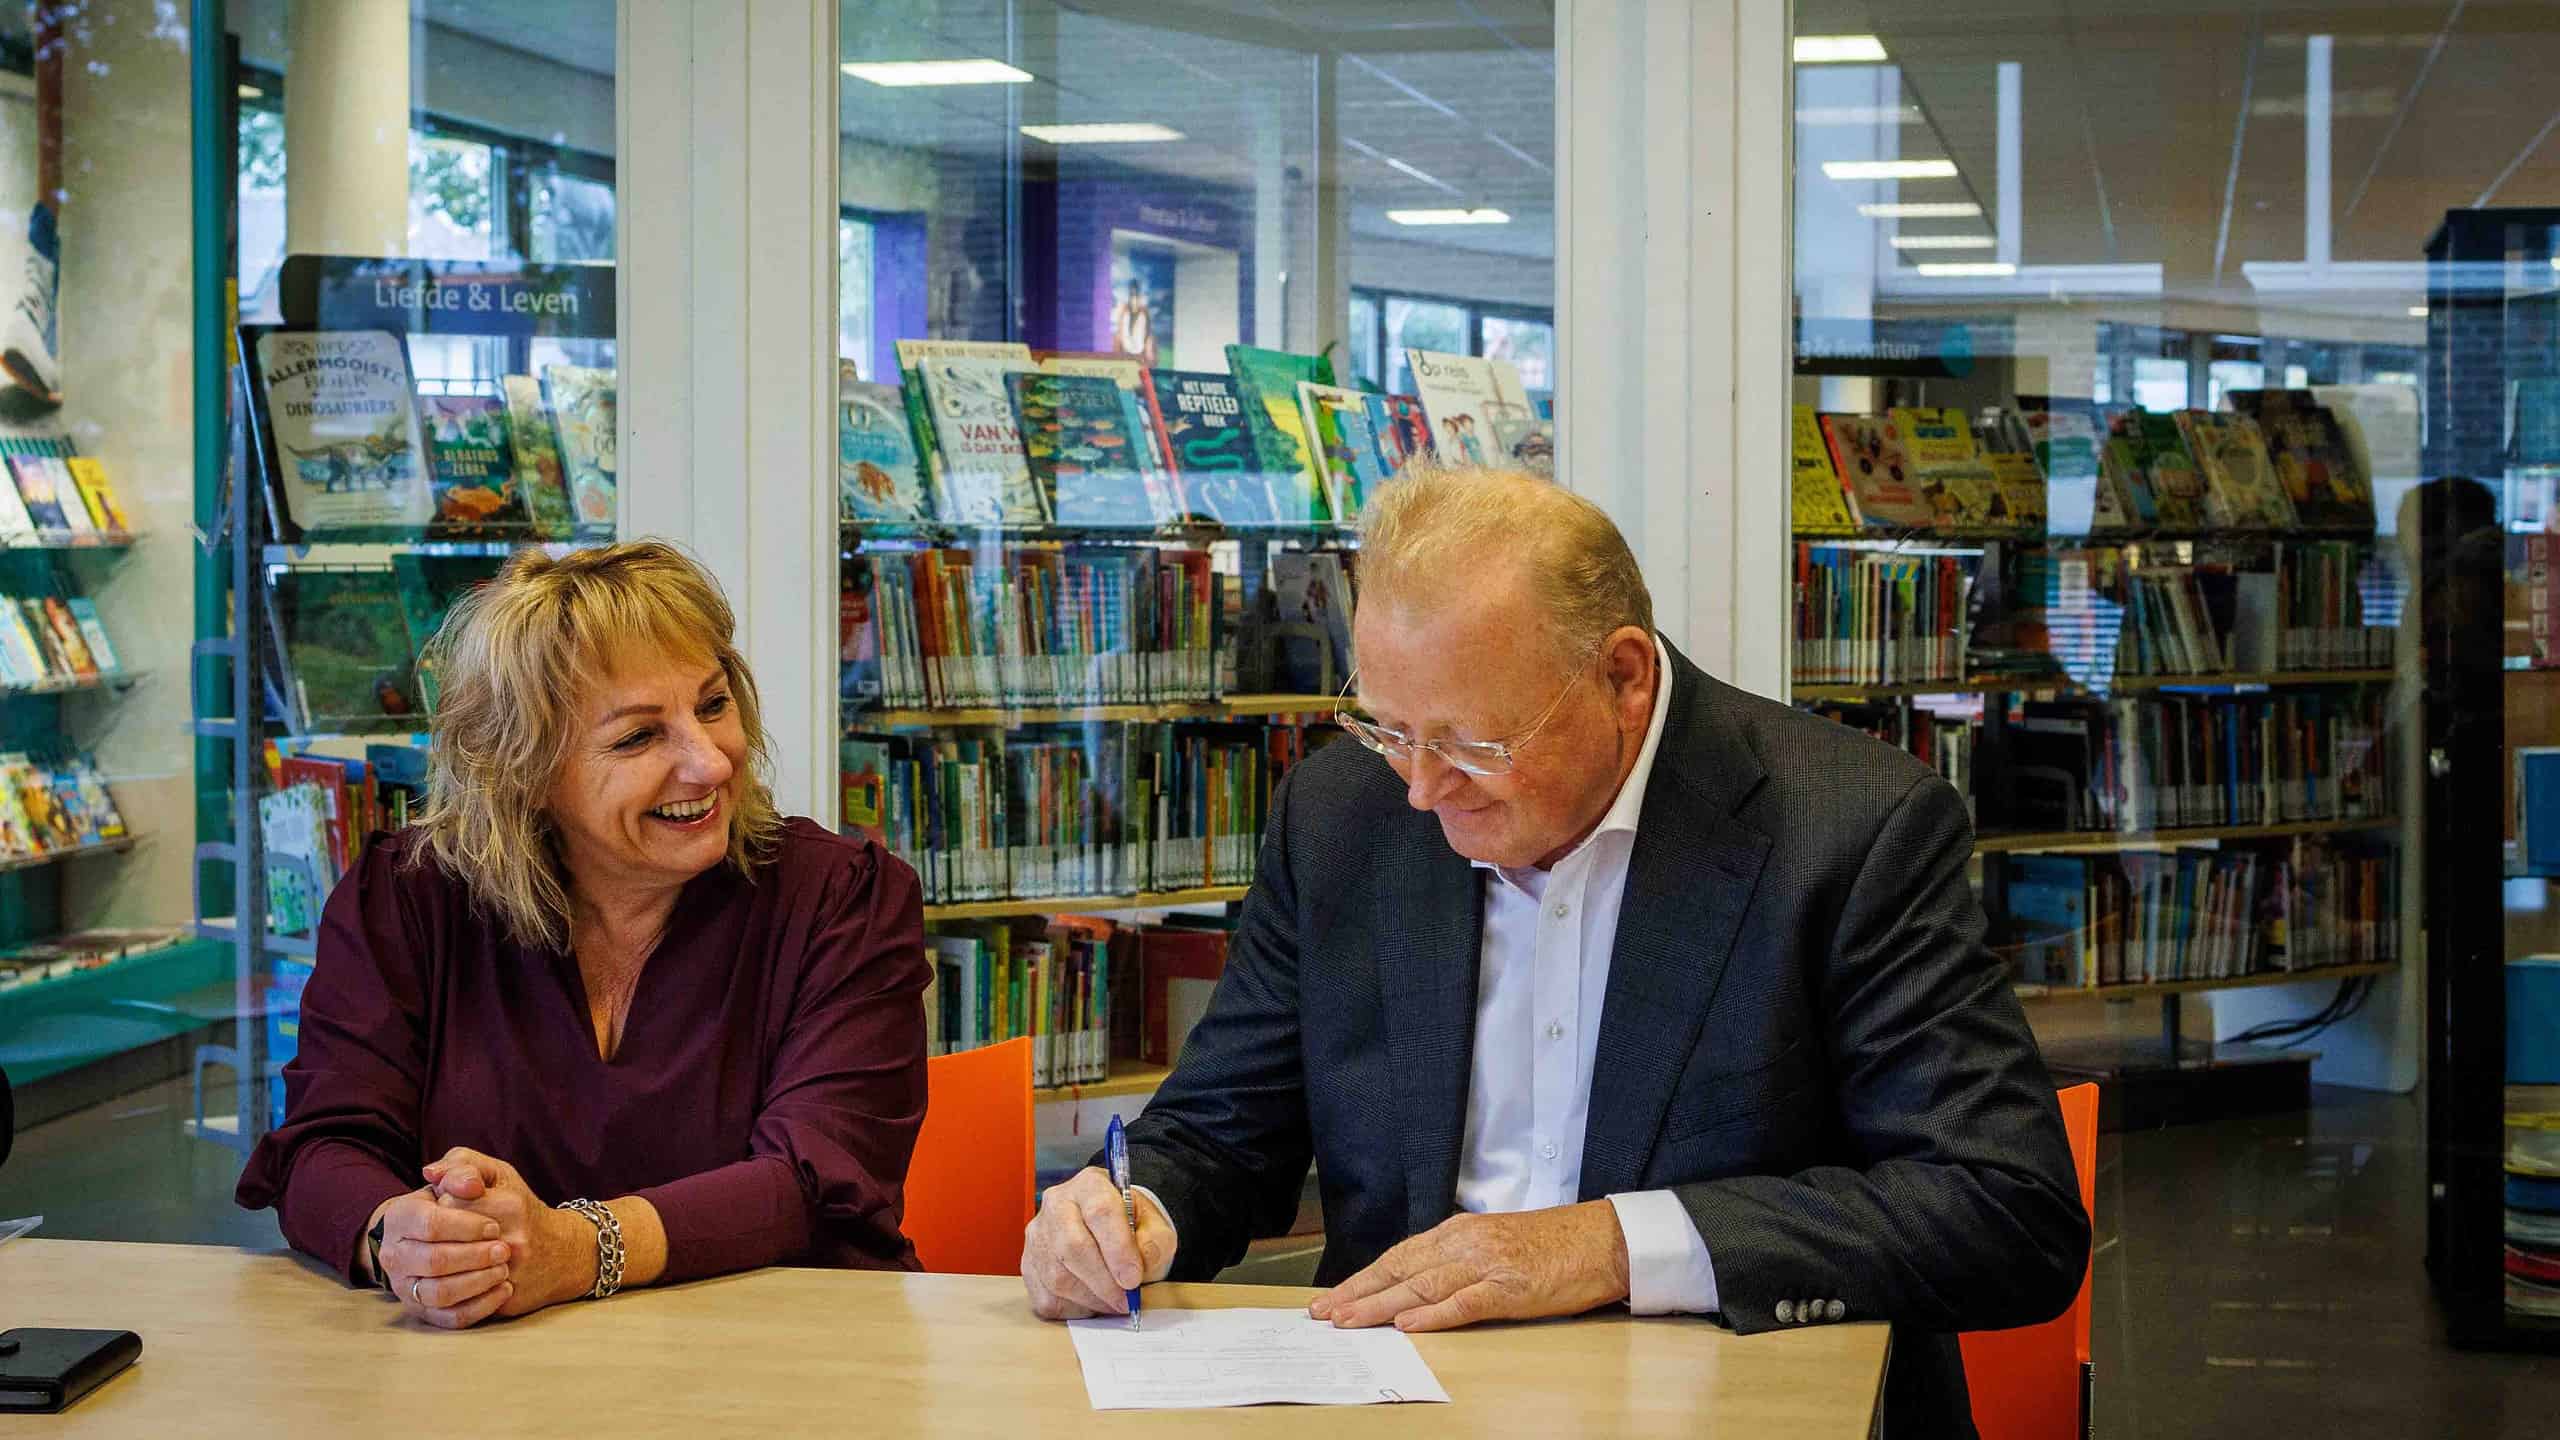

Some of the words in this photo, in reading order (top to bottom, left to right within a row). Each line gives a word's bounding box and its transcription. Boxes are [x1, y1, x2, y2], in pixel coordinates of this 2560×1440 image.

[374, 279, 460, 310] Liefde
[468, 282, 492, 312] &
[500, 283, 579, 314] Leven
[267, 356, 404, 386] ALLERMOOISTE
[958, 422, 1001, 440] VAN
[1003, 424, 1023, 441] W
